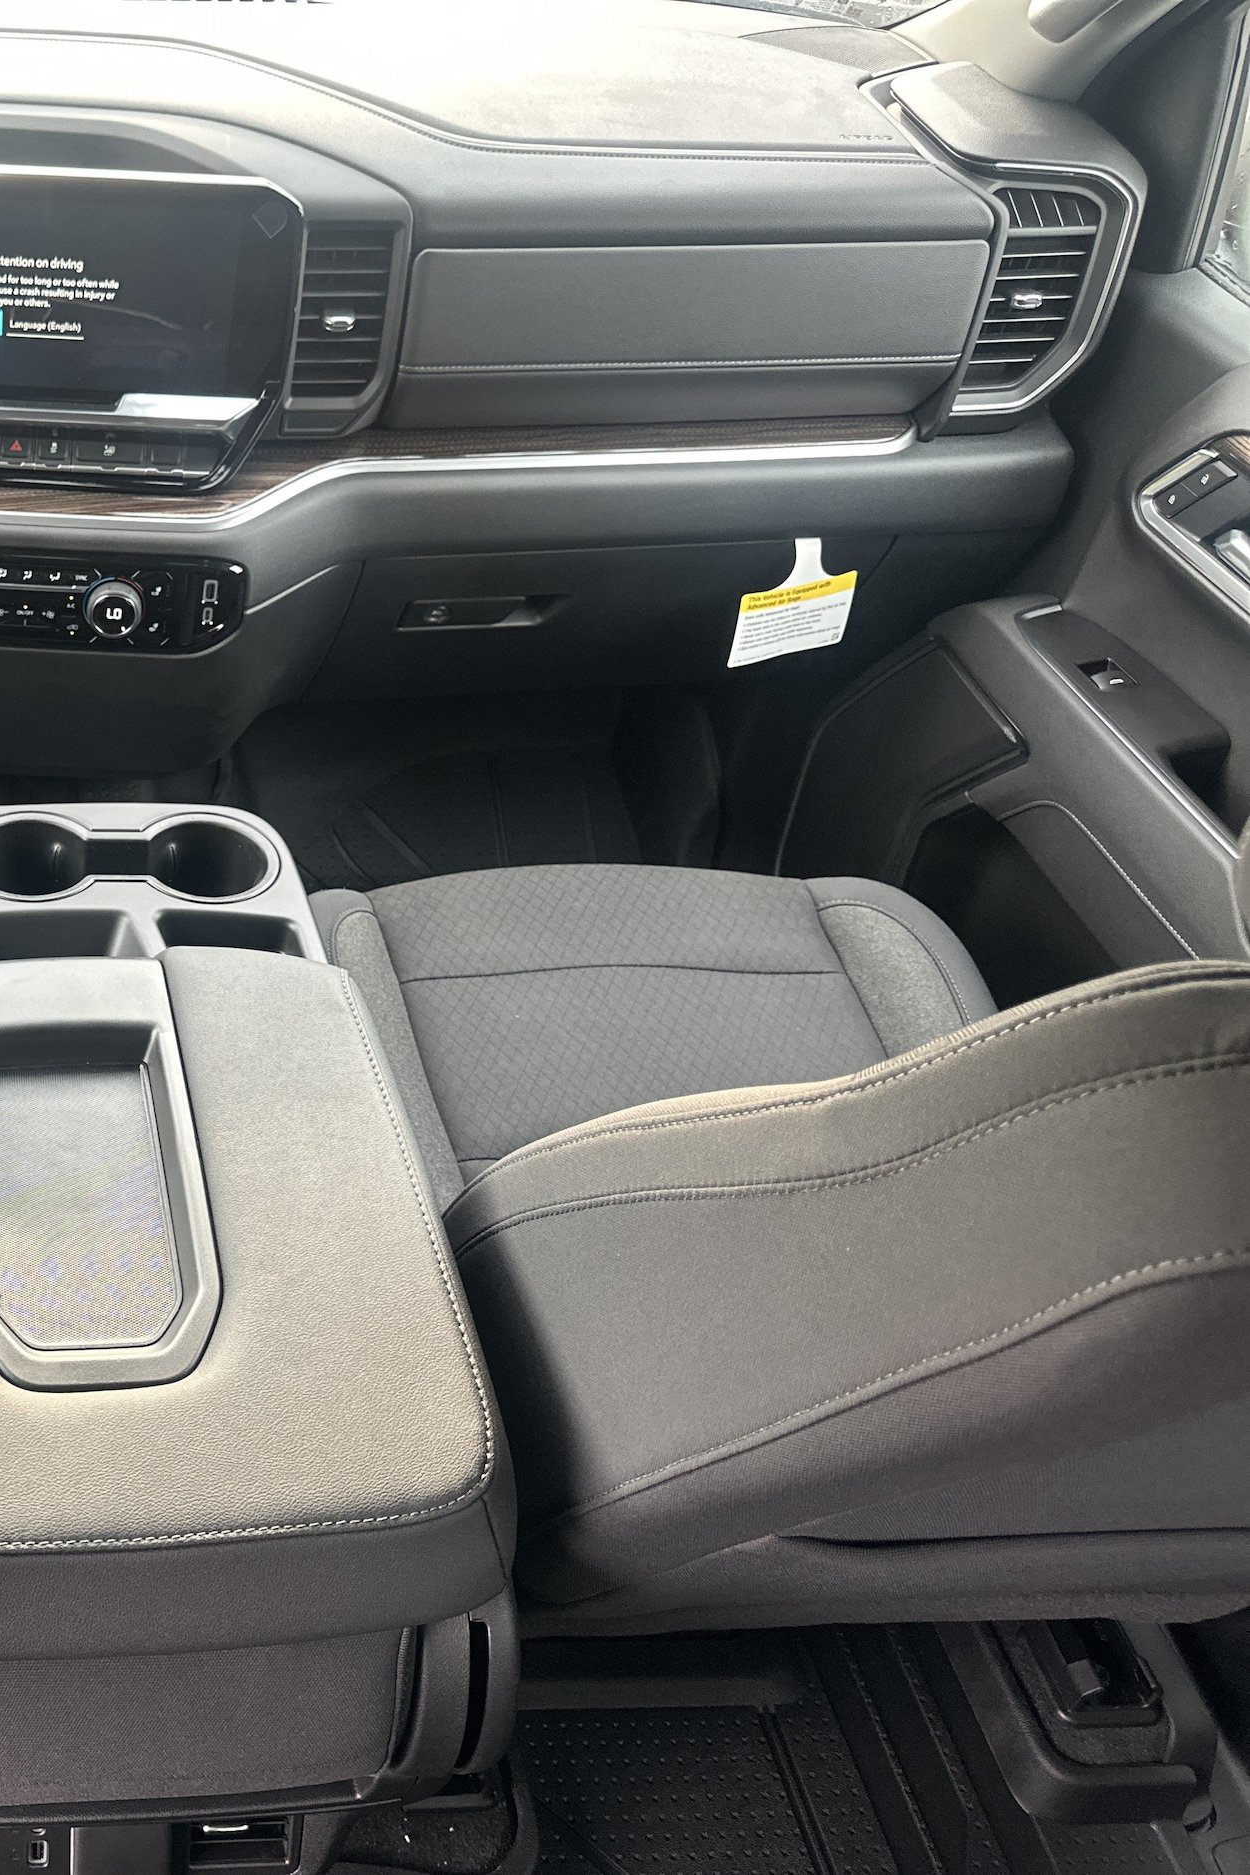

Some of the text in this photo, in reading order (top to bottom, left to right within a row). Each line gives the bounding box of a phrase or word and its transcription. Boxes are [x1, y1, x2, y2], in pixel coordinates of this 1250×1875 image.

[36, 259, 49, 268] on
[50, 256, 84, 273] driving
[7, 274, 19, 285] for
[20, 276, 34, 285] too
[34, 275, 52, 288] long
[53, 278, 62, 287] or
[62, 278, 76, 287] too
[77, 278, 98, 288] often
[99, 279, 120, 289] while
[19, 287, 41, 297] crash
[41, 288, 74, 300] resulting
[75, 290, 83, 298] in
[83, 290, 106, 302] injury
[106, 292, 116, 300] or
[0, 297, 13, 307] you
[14, 299, 23, 307] or
[23, 298, 51, 308] others.
[9, 318, 82, 334] Language (English)
[747, 601, 777, 611] Advanced
